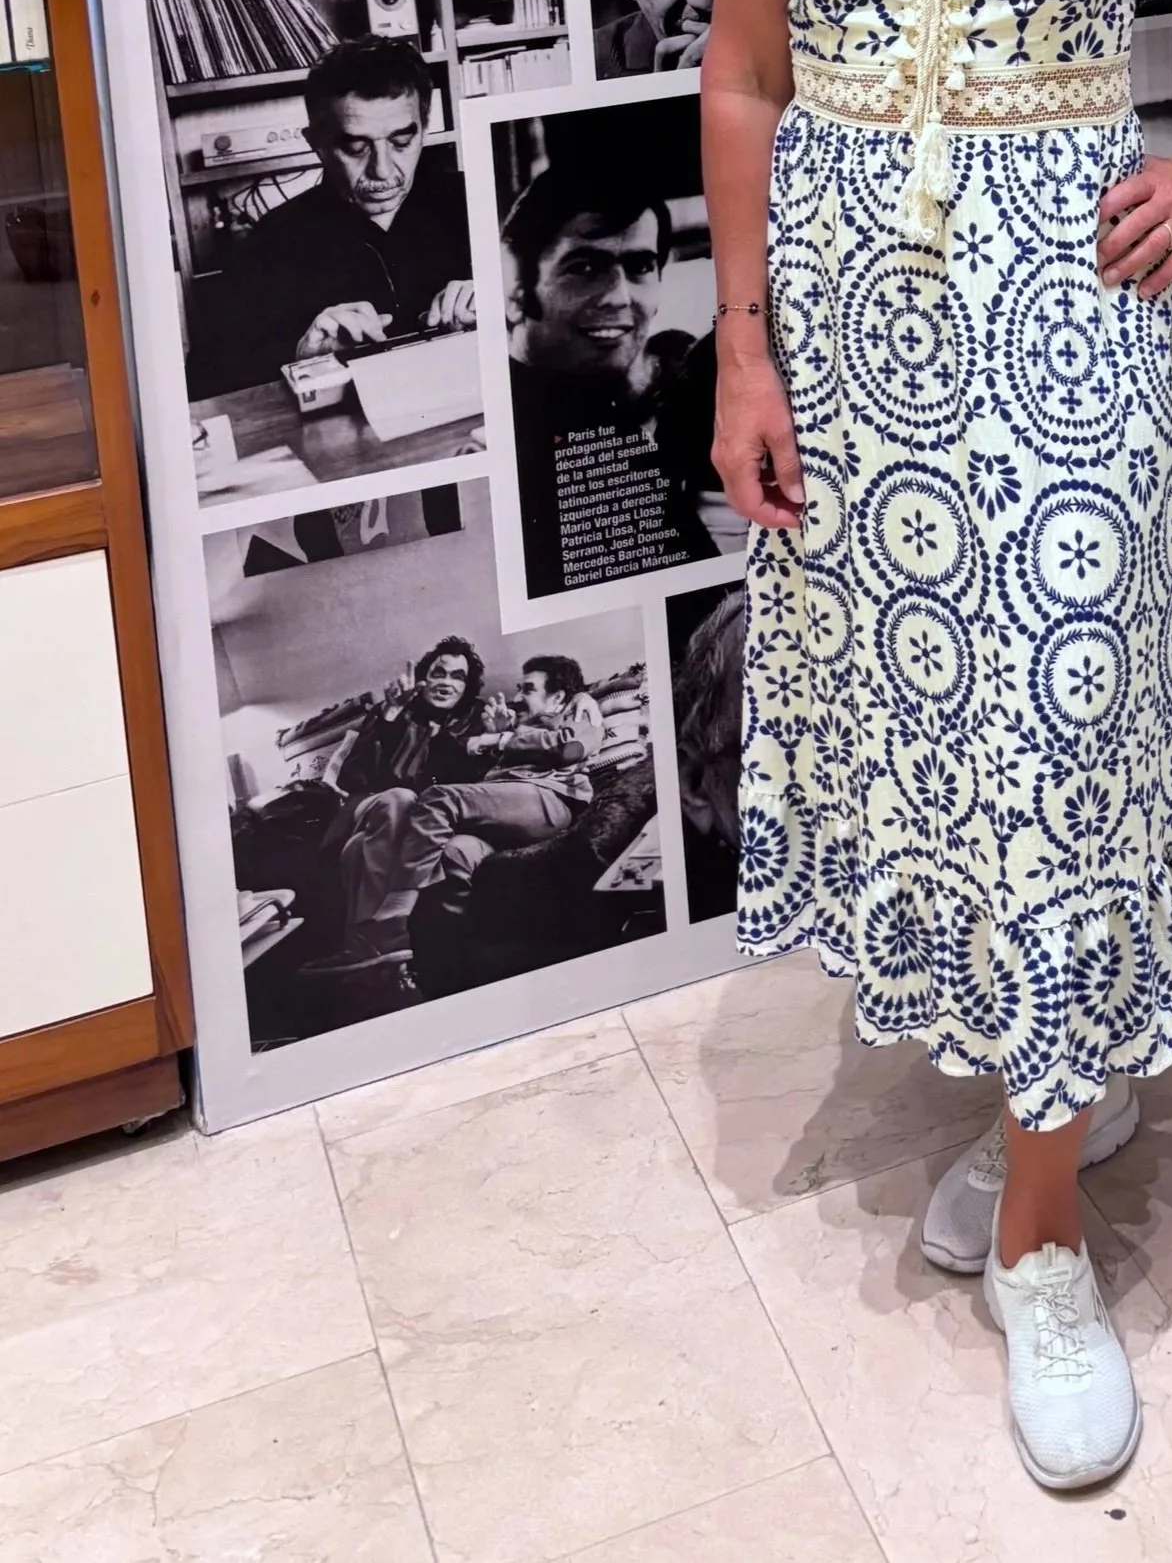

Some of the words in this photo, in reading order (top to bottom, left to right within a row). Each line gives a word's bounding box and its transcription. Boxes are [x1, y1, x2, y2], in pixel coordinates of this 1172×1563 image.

[598, 425, 616, 437] fue
[555, 436, 623, 460] protagonista
[626, 433, 639, 444] en
[556, 456, 595, 471] década
[598, 450, 615, 463] del
[617, 442, 659, 459] sesenta
[556, 473, 571, 484] de
[573, 470, 584, 481] la
[586, 459, 629, 478] amistad
[557, 483, 586, 497] entre
[588, 480, 605, 491] los
[607, 468, 661, 486] escritores
[558, 482, 654, 510] latinoamericanos.
[656, 478, 670, 489] De
[560, 504, 609, 523] izquierda
[612, 502, 619, 512] a
[622, 492, 668, 510] derecha:
[560, 521, 591, 536] Mario
[594, 513, 631, 527] Vargas
[633, 506, 665, 519] Llosa,
[562, 531, 602, 549] Patricia
[605, 524, 637, 539] Llosa,
[639, 518, 663, 531] Pilar
[562, 544, 608, 561] Serrano,
[610, 536, 635, 551] José
[638, 528, 680, 544] Donoso,
[563, 554, 616, 574] Mercedes
[618, 546, 656, 561] Barcha
[658, 543, 665, 554] y
[564, 569, 602, 586] Gabriel
[642, 550, 690, 568] Márquez.
